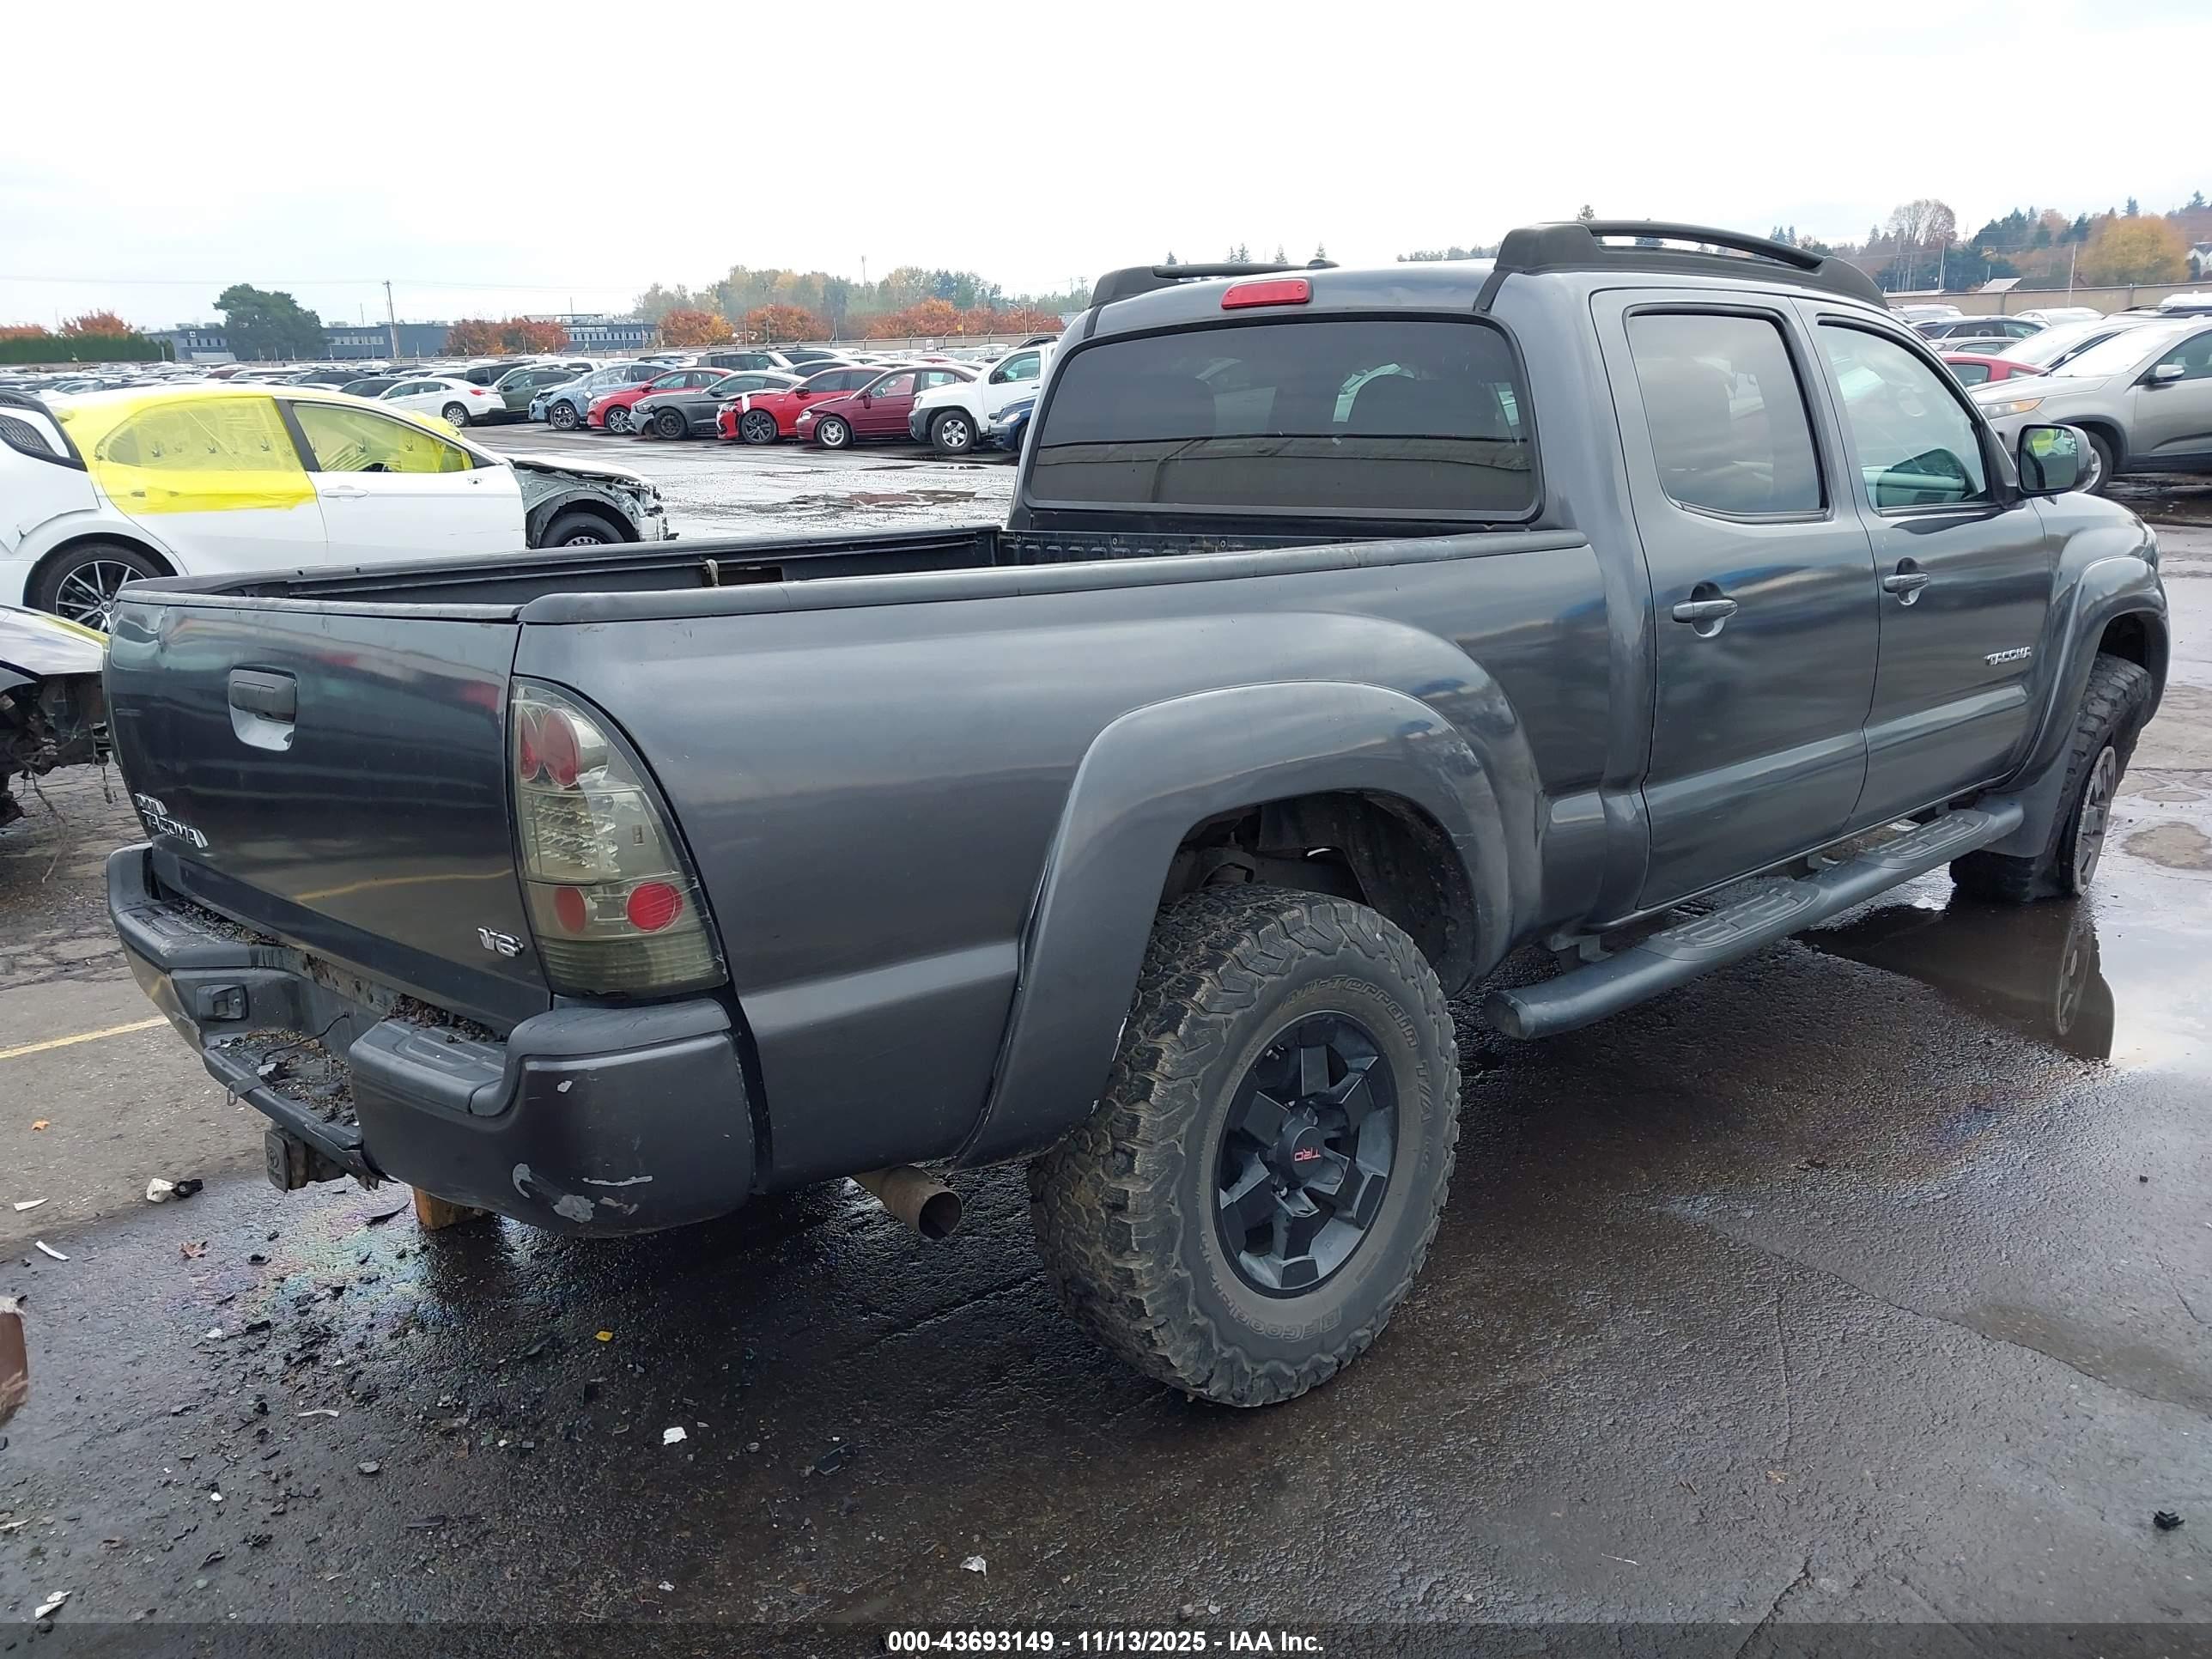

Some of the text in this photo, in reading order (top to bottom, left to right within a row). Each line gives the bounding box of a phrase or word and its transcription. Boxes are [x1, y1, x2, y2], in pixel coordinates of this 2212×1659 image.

[1984, 646, 2032, 665] TACOMA
[141, 809, 209, 848] TACOMA
[477, 927, 524, 957] V6
[1294, 1147, 1322, 1162] TRD
